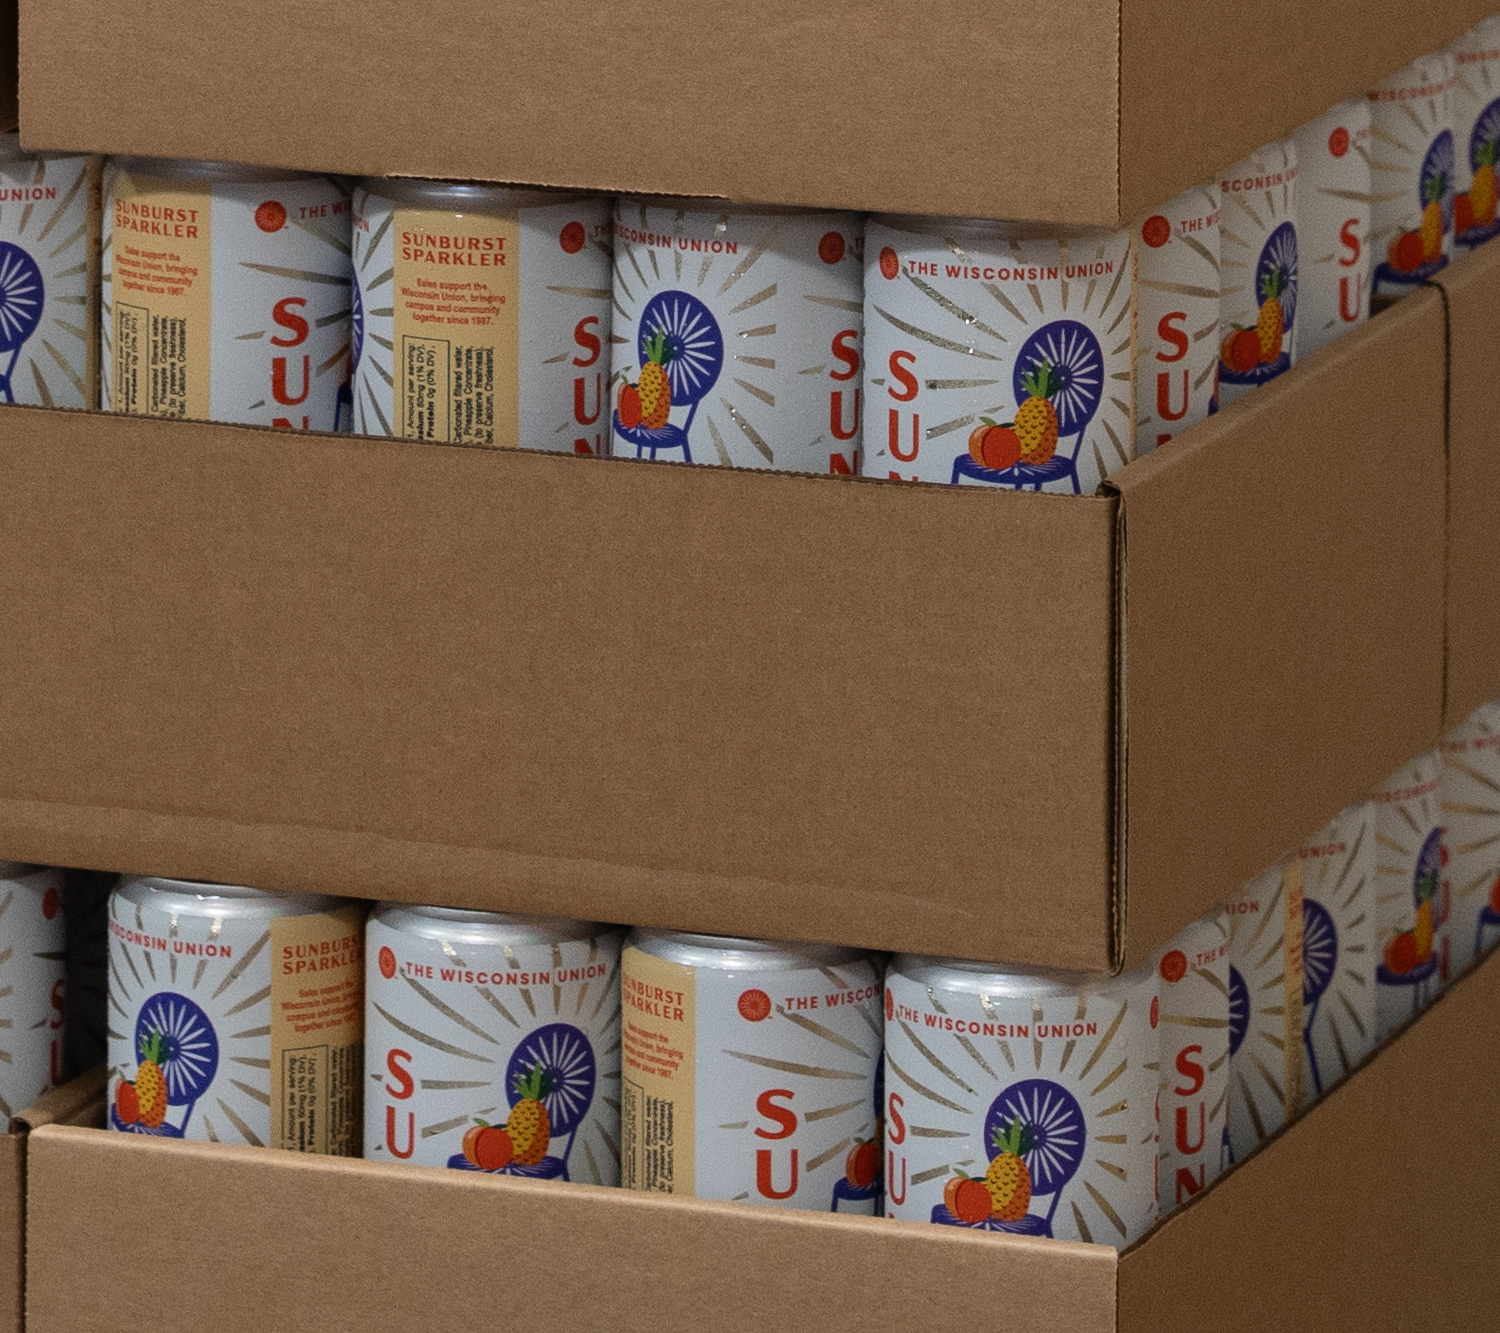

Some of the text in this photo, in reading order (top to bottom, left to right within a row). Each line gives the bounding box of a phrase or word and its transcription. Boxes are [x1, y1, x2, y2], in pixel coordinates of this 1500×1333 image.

[116, 199, 199, 223] SUNBURST
[116, 214, 198, 239] SPARKLER
[402, 231, 507, 251] SUNBURST
[678, 237, 738, 254] UNION
[402, 247, 506, 266] SPARKLER
[908, 260, 1113, 281] THE WISCONSIN UNION
[173, 942, 232, 958] UNION
[283, 934, 358, 959] SUNBURS
[405, 961, 606, 985] THE WISCONSIN UNION
[785, 996, 818, 1011] THE
[899, 1005, 1097, 1038] THE WISCONSIN UNION
